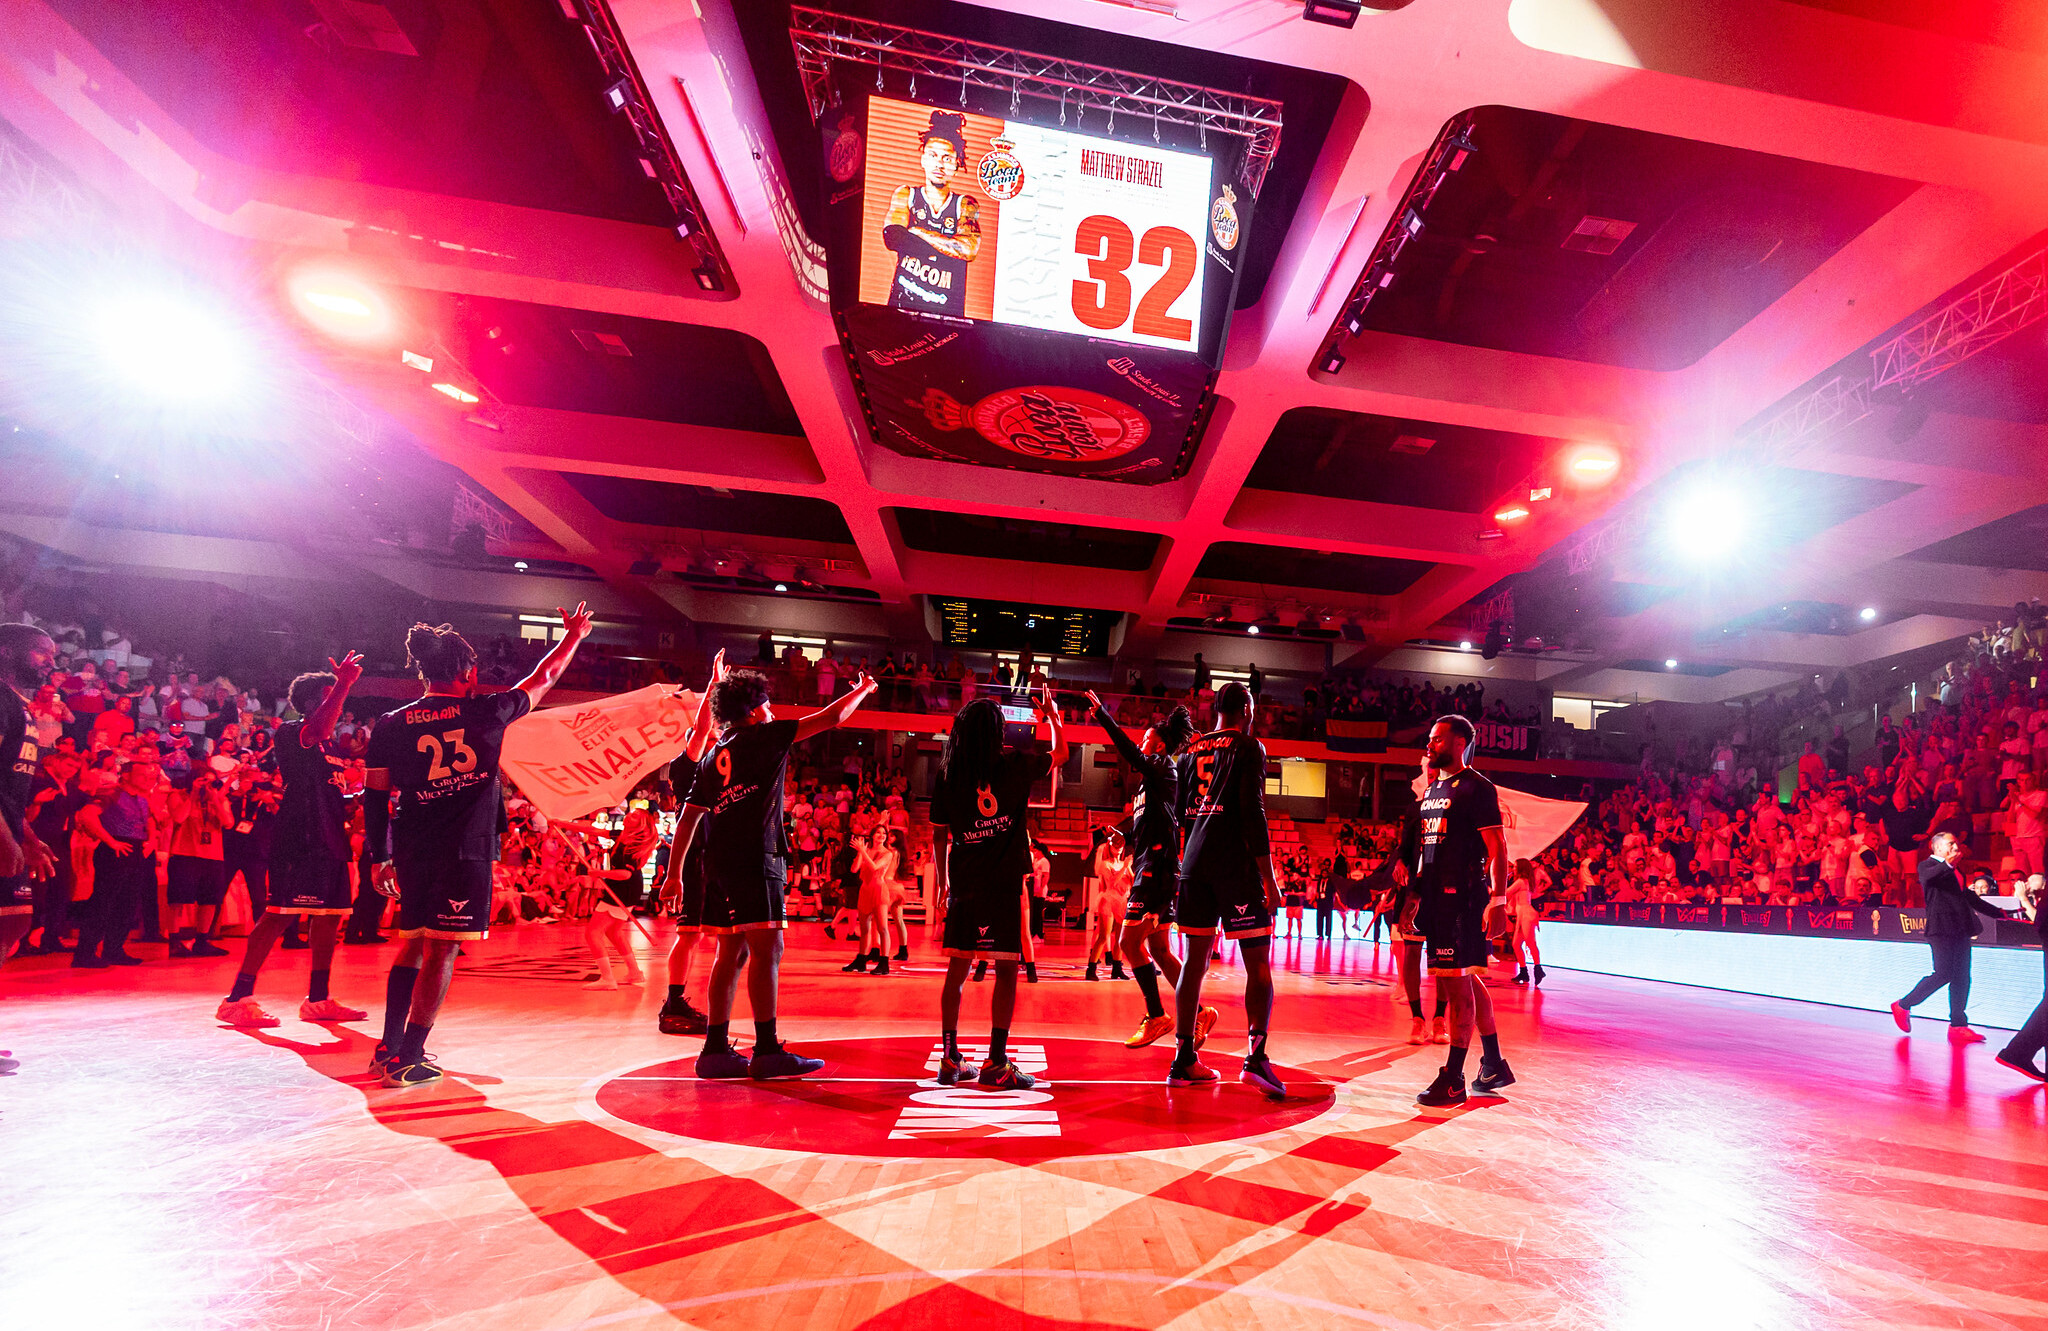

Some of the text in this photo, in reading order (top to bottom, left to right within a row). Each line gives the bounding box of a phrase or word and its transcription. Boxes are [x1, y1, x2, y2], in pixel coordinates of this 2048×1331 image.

[1081, 149, 1163, 188] MATTHEW STRAZEL
[1071, 214, 1198, 341] 32
[1010, 393, 1078, 458] Roca
[1118, 417, 1145, 449] BASKET
[1130, 670, 1137, 680] K
[405, 704, 461, 725] BEGARIN
[417, 728, 478, 781] 23
[539, 708, 681, 790] FINALES
[716, 748, 732, 787] 9
[1196, 755, 1215, 796] 5
[963, 829, 994, 841] MICHEL
[974, 815, 1009, 829] GROUPE
